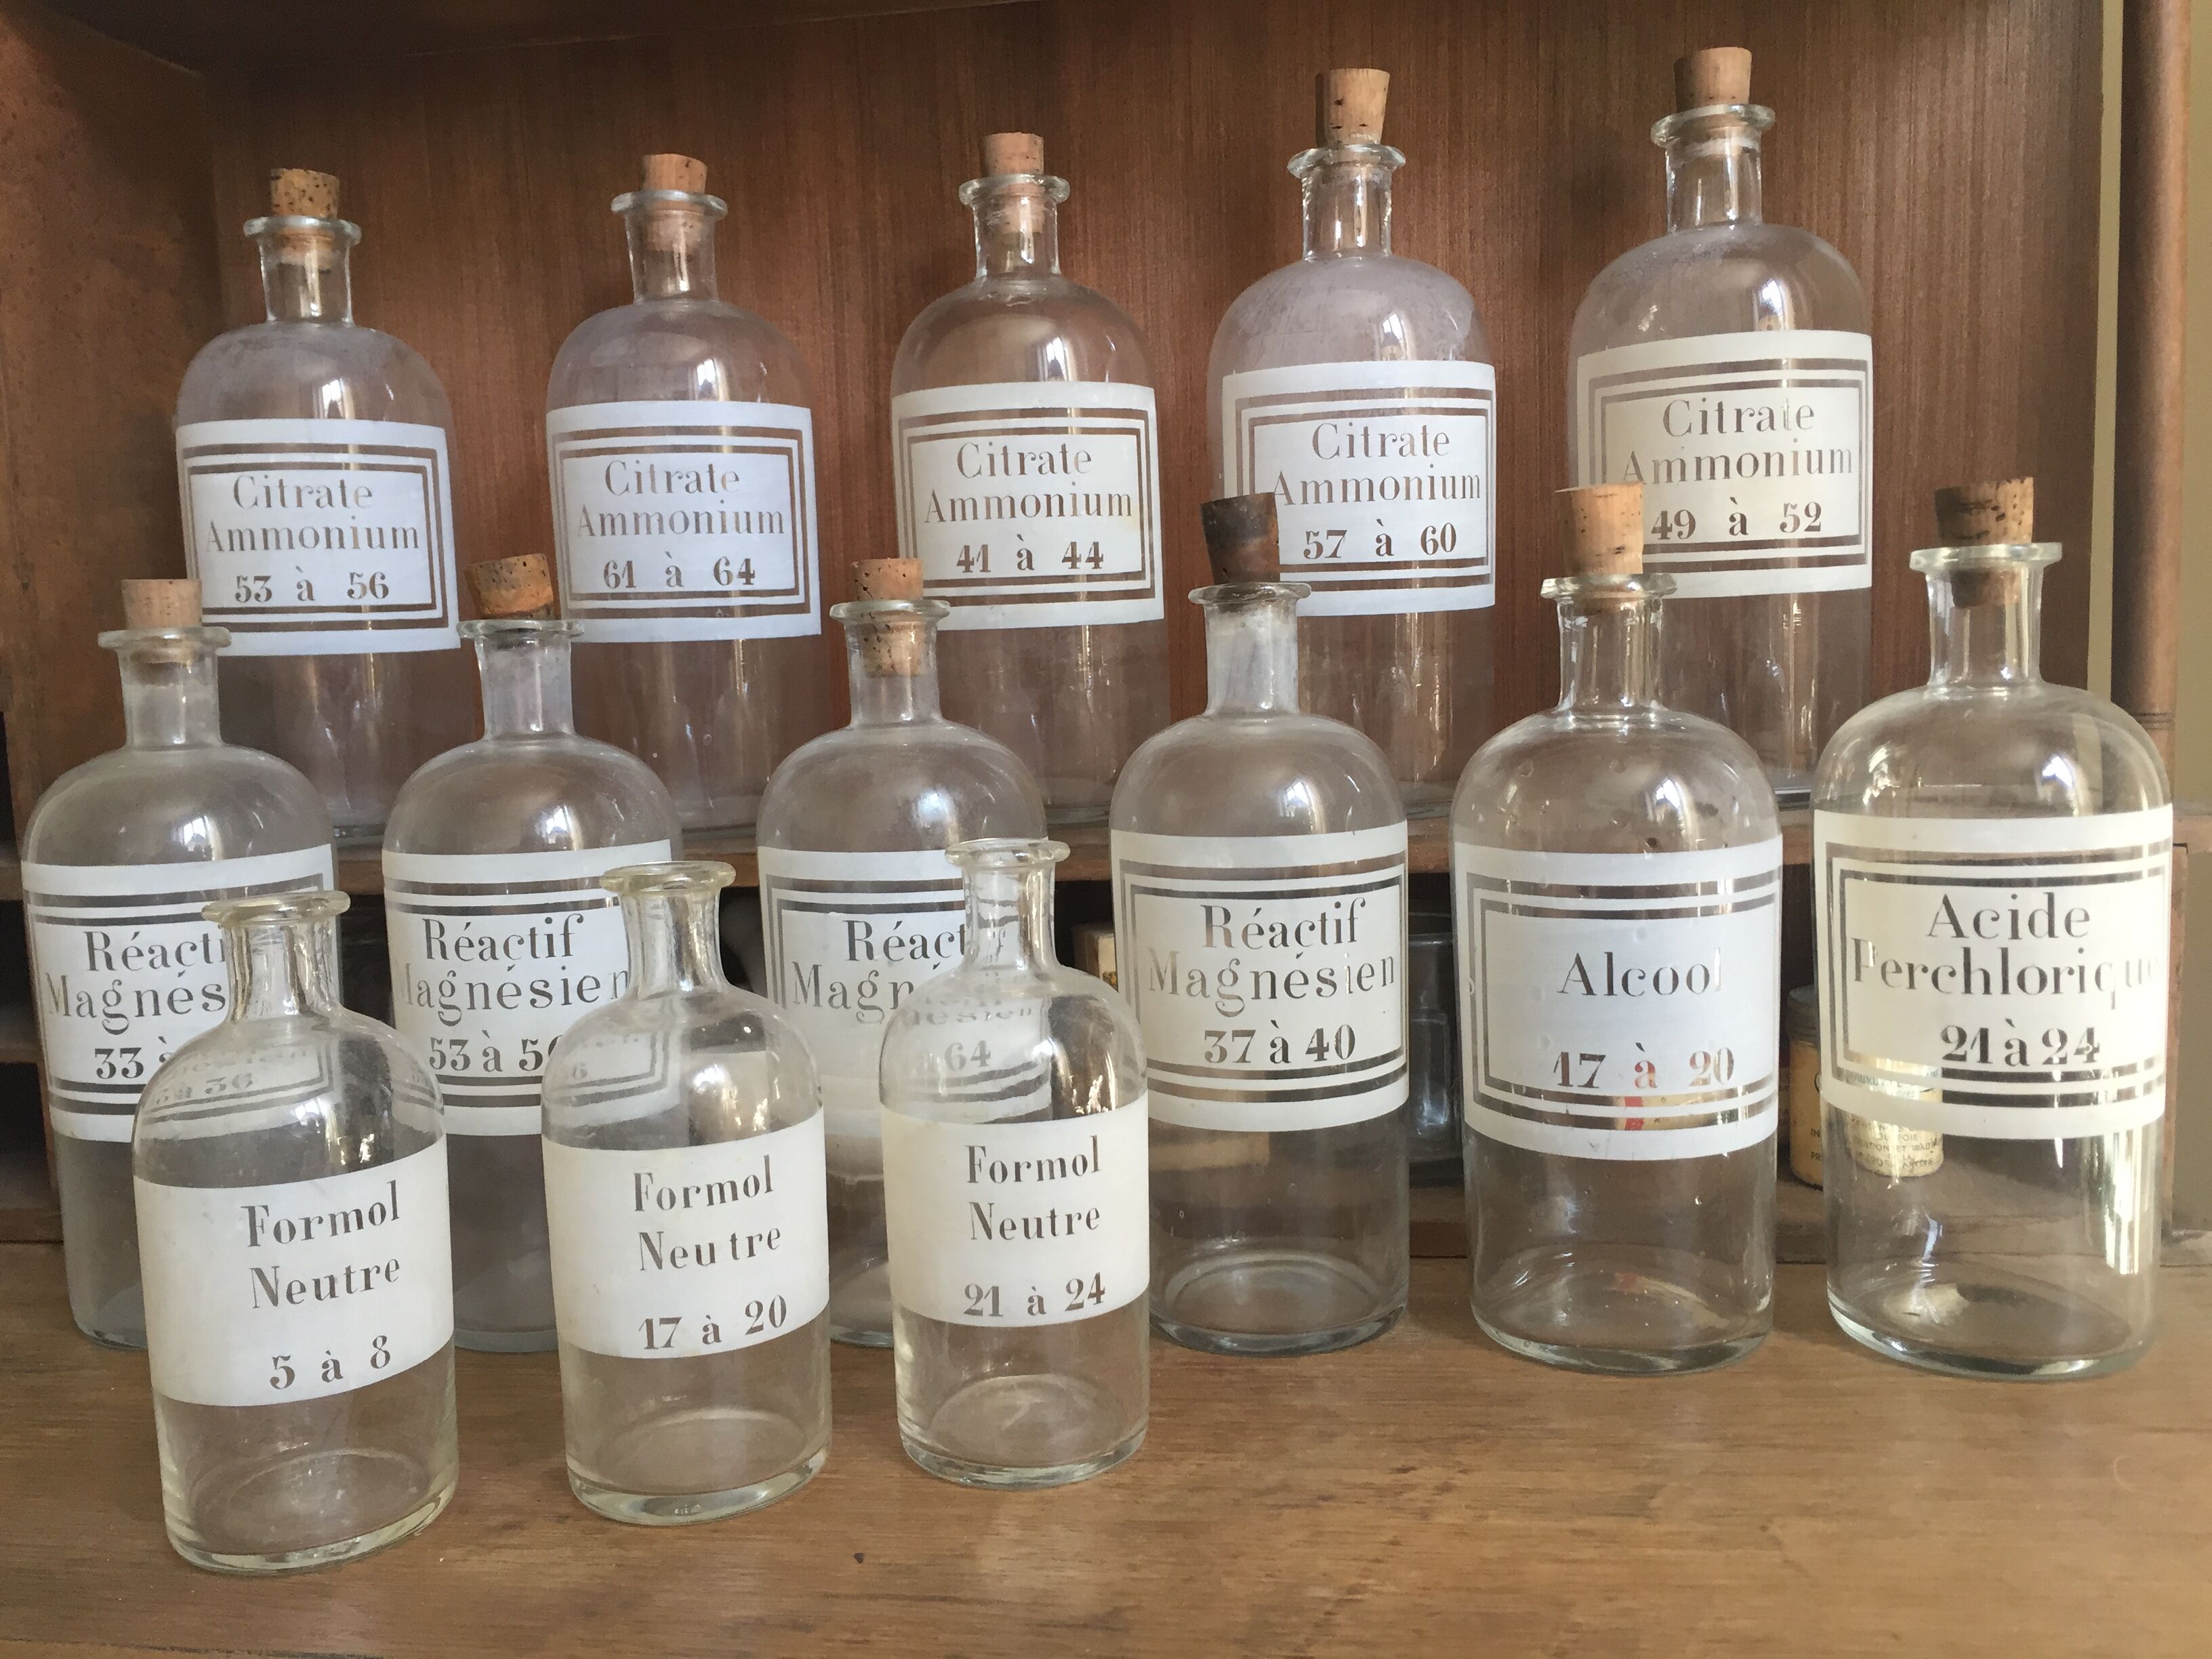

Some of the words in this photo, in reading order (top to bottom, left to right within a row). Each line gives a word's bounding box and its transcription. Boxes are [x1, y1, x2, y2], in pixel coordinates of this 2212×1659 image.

[1662, 397, 1815, 437] Citrate
[957, 442, 1092, 479] Citrate
[1312, 422, 1450, 460] Citrate
[1623, 438, 1853, 485] Ammonium
[233, 474, 373, 509] Citrate
[605, 459, 740, 496] Citrate
[1273, 463, 1481, 506] Ammonium
[577, 499, 785, 537] Ammonium
[924, 480, 1133, 523] Ammonium
[1651, 509, 1696, 541] 49
[1729, 497, 1748, 536] à
[1779, 501, 1822, 534] 52
[206, 516, 419, 552] Ammonium
[956, 544, 991, 573] 41
[1016, 533, 1035, 571] à
[1061, 541, 1105, 570] 44
[1303, 529, 1347, 560] 57
[1375, 518, 1394, 556] à
[1420, 523, 1457, 556] 60
[235, 575, 272, 603] 53
[295, 565, 316, 601] à
[346, 571, 390, 600] 56
[603, 560, 636, 589] 61
[664, 551, 684, 588] à
[713, 556, 756, 586] 64
[422, 914, 584, 962] Réactif
[1200, 897, 1366, 950] Réactif
[1926, 891, 2090, 941] Acide
[83, 924, 226, 972] Réacti
[842, 920, 965, 962] Réact
[1148, 947, 1395, 1018] Magnésien
[1557, 947, 1722, 998] Alcool
[44, 970, 226, 1036] Magnés
[94, 1047, 144, 1080] 33
[429, 1036, 471, 1071] 53
[482, 1029, 504, 1072] à
[945, 1040, 991, 1071] 64
[1204, 1029, 1256, 1064] 37
[1269, 1019, 1290, 1064] à
[1305, 1024, 1355, 1063] 40
[1940, 1024, 1992, 1064] 21
[2003, 1018, 2030, 1067] à
[2042, 1026, 2101, 1066] 24
[1553, 1051, 1606, 1089] 17
[1634, 1042, 1658, 1088] à
[1687, 1046, 1735, 1088] 20
[964, 1134, 1102, 1183] Formol
[633, 1154, 774, 1212] Formol
[240, 1179, 401, 1248] Formol
[968, 1201, 1101, 1240] Neutre
[637, 1227, 781, 1271] Neutre
[249, 1258, 401, 1309] Neutre
[962, 1282, 1004, 1317] 21
[1027, 1286, 1046, 1317] à
[1063, 1271, 1105, 1313] 24
[638, 1316, 682, 1350] 17
[701, 1314, 722, 1345] à
[744, 1294, 787, 1336] 20
[269, 1354, 295, 1390] 5
[321, 1350, 344, 1383] à
[370, 1334, 391, 1369] 8
